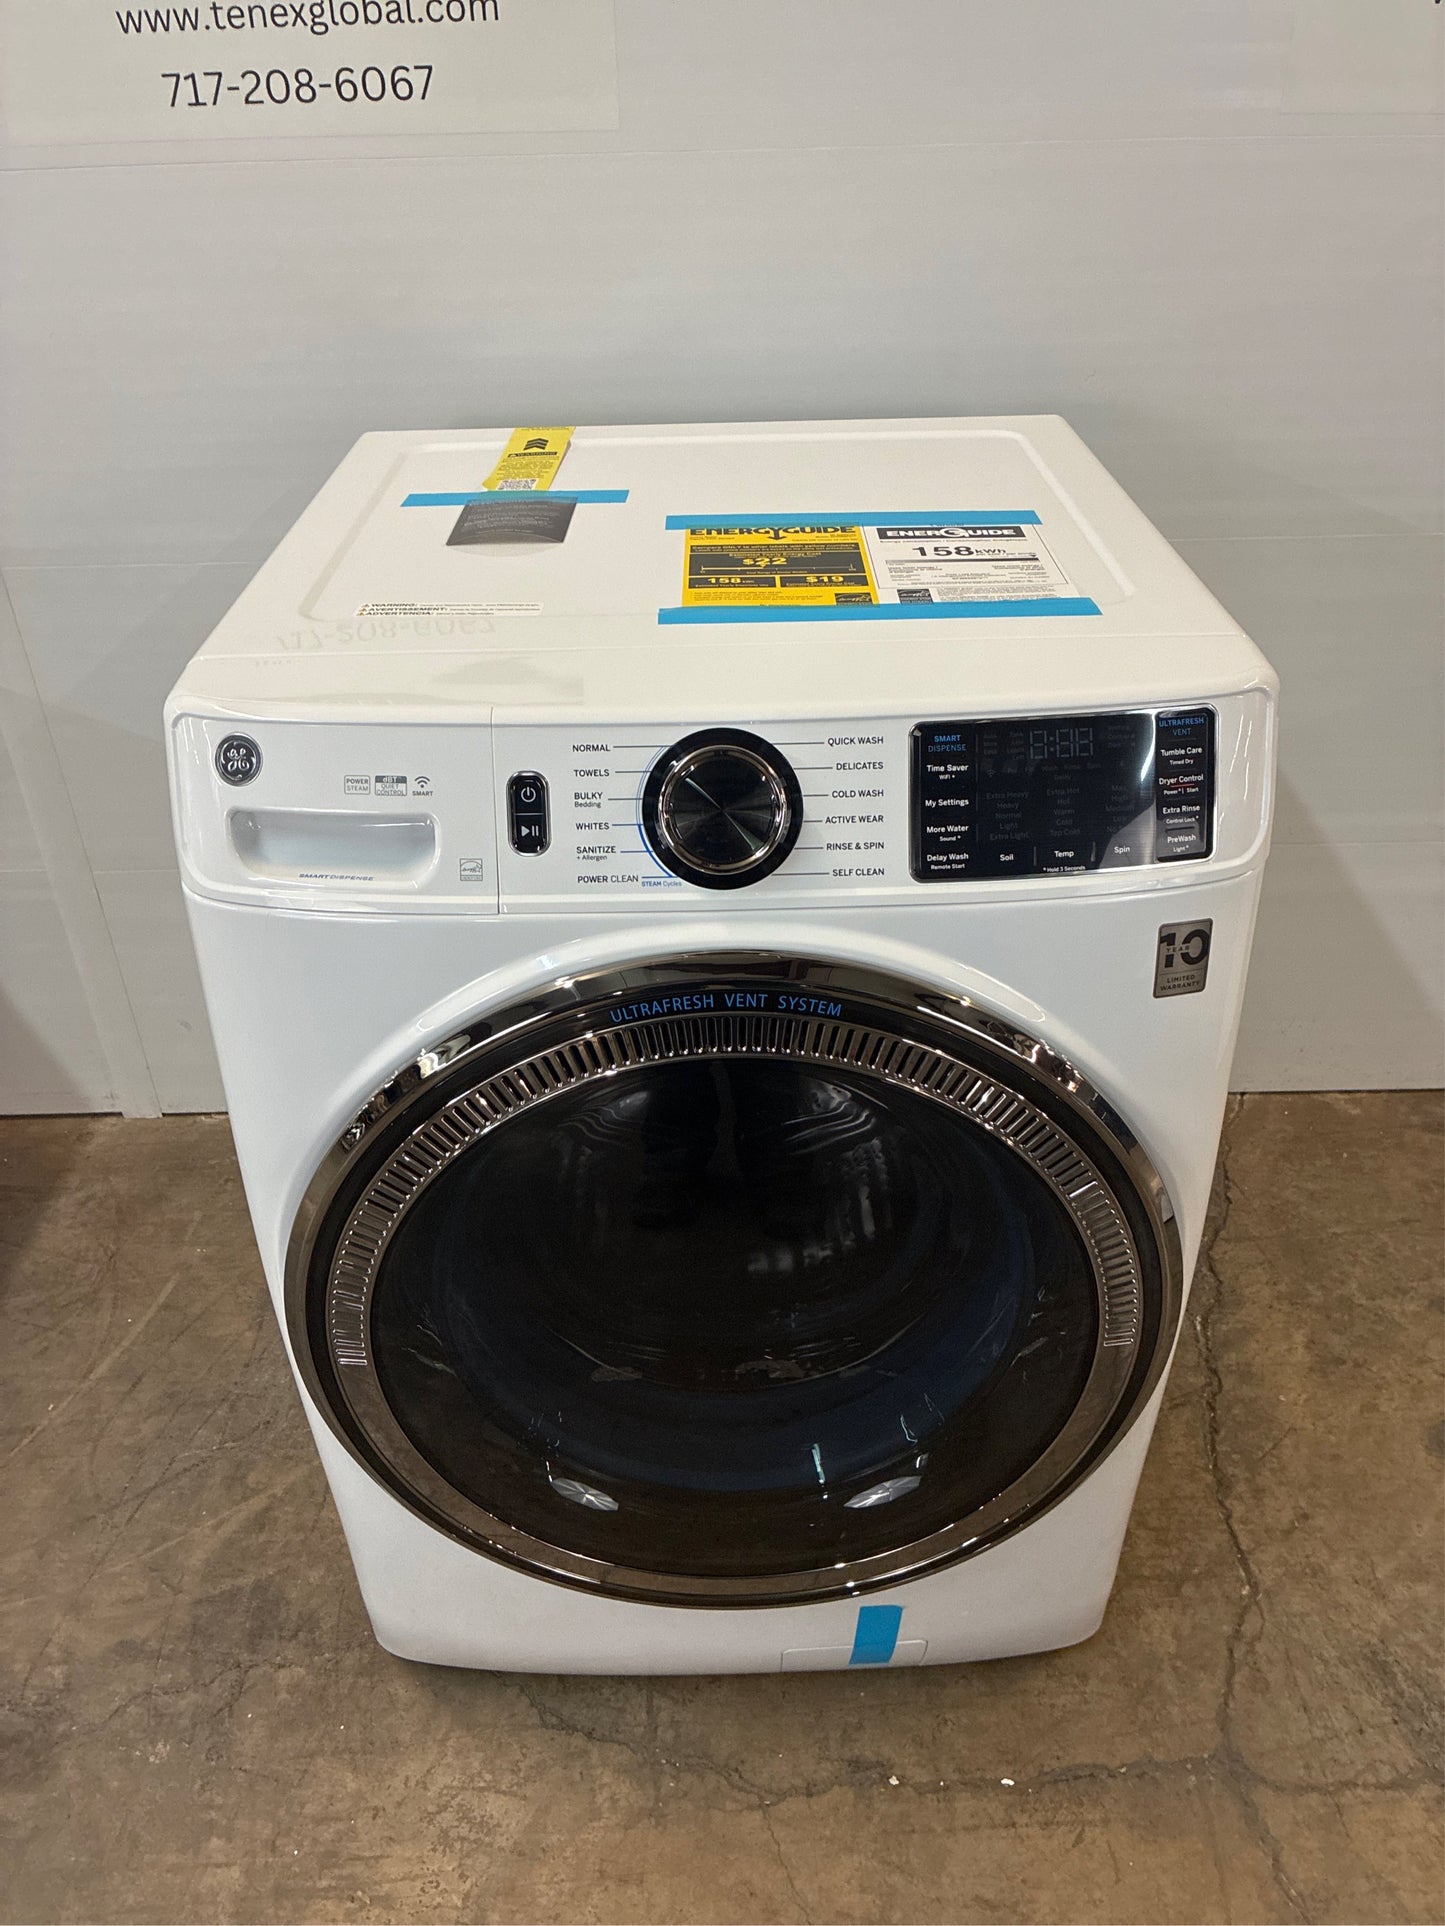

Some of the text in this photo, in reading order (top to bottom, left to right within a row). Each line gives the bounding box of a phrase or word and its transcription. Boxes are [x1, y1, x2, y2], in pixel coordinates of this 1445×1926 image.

[115, 0, 500, 36] www.tenexglobal.com
[160, 64, 434, 108] 717-208-6067
[689, 525, 856, 538] ENERGYGUIDE
[912, 546, 974, 557] 158
[743, 557, 787, 565] $22
[1159, 717, 1205, 727] ULTRAFRESH
[1172, 728, 1192, 736] VENT
[827, 736, 884, 747] QUICK WASH
[934, 735, 961, 743] SMART
[572, 744, 611, 752] NORMAL
[928, 743, 967, 752] DISPENSE
[1160, 746, 1203, 757] Tumble Care
[836, 762, 884, 770] DELICATES
[926, 764, 969, 773] Time Saver
[574, 769, 610, 777] TOWELS
[1158, 774, 1204, 786] Dryer Control
[574, 792, 603, 800] BULKY
[832, 789, 884, 798] COLD WASH
[925, 798, 969, 808] My Settings
[1163, 807, 1180, 815] Extra
[825, 815, 884, 824] ACTIVE WEAR
[575, 822, 610, 830] WHITES
[926, 825, 969, 833] More Water
[1167, 834, 1197, 843] PreWash
[576, 845, 616, 854] SANITIZE
[855, 842, 862, 850] &
[863, 842, 885, 850] SPIN
[1113, 846, 1131, 854] Spin
[582, 854, 608, 862] Allergen
[926, 854, 947, 862] Delay
[1054, 851, 1075, 859] Temp
[855, 868, 885, 876] CLEAN
[577, 875, 639, 883] POWER CLEAN
[1160, 929, 1210, 968] 10
[1167, 974, 1195, 983] LIMITED
[1160, 981, 1200, 991] WARRANTY
[609, 993, 843, 1023] ULTRAFRESH VENT SYSTEM
